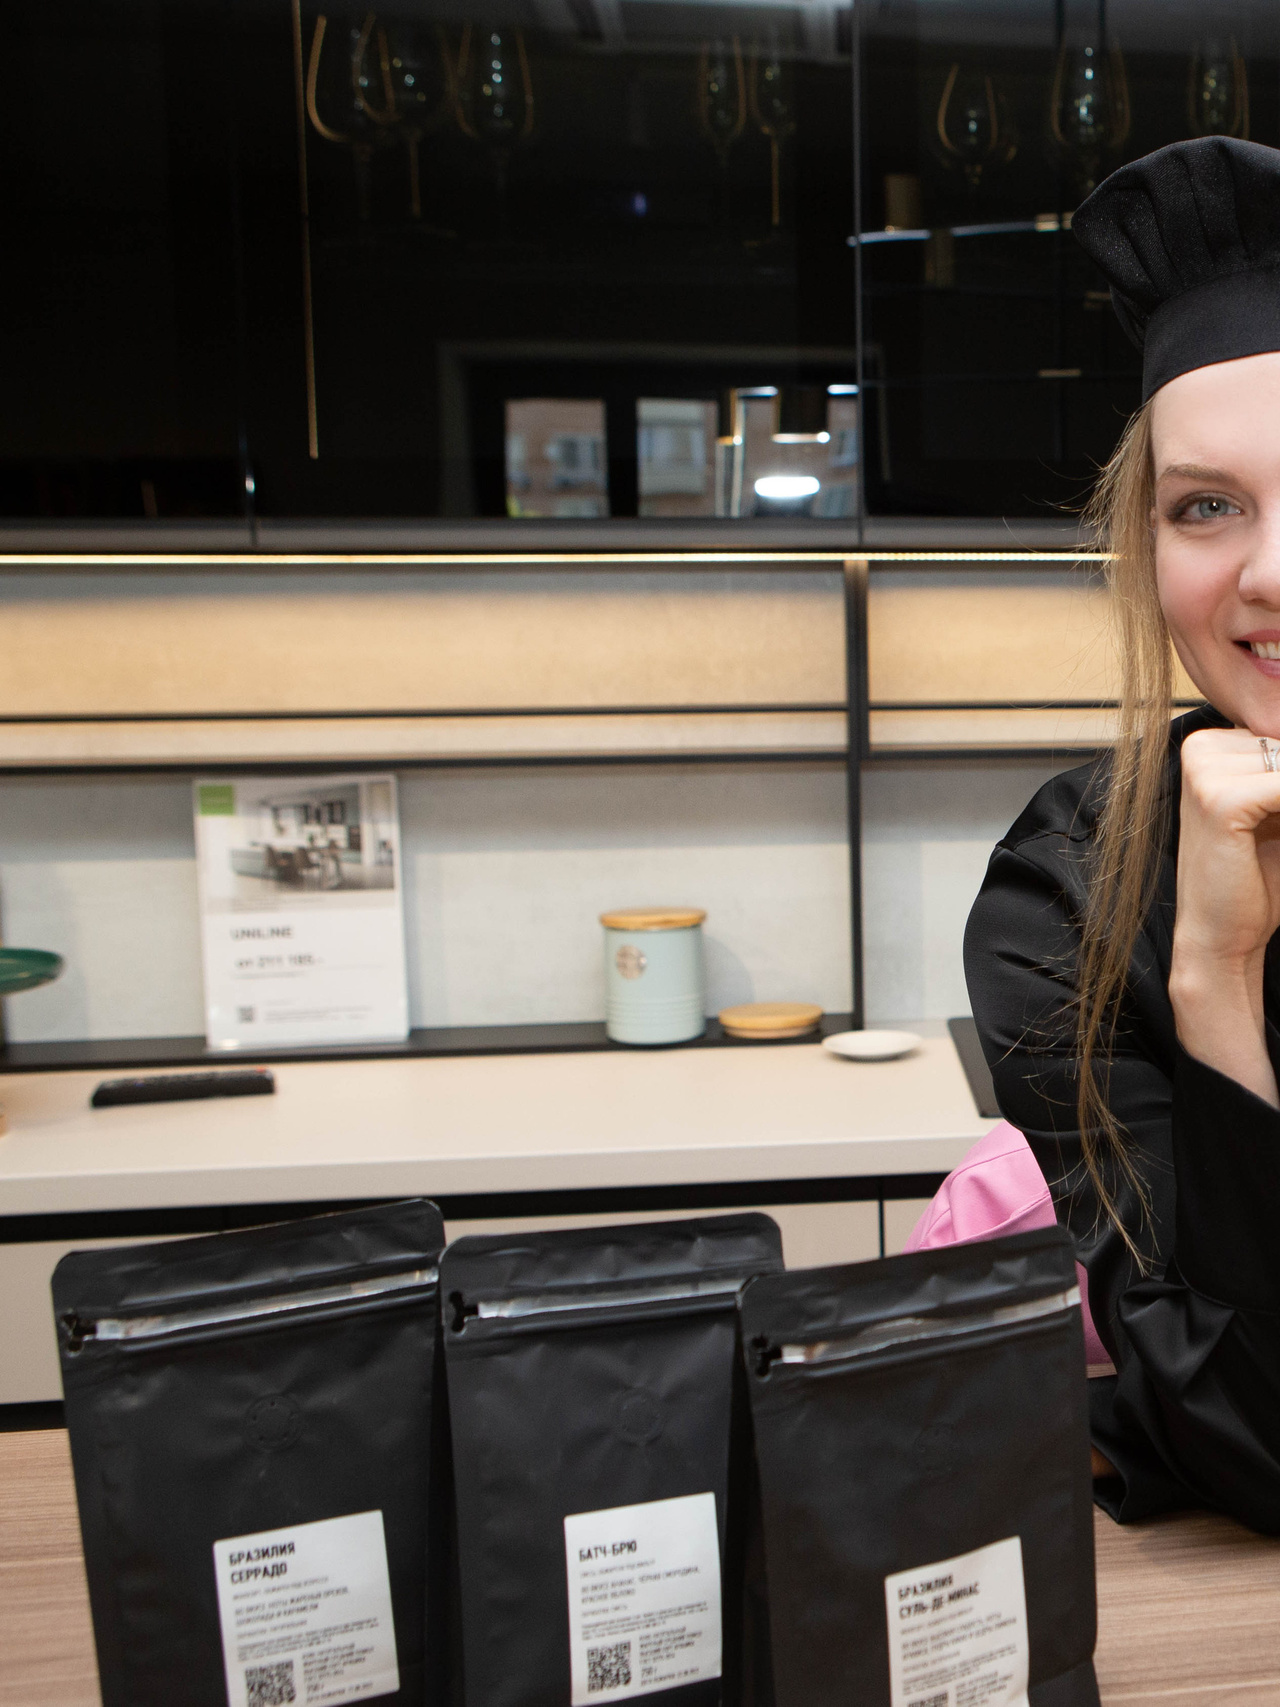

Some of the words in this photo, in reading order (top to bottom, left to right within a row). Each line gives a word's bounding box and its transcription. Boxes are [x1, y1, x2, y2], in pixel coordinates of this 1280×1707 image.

[229, 1542, 295, 1566] БРАЗИЛИЯ
[579, 1540, 637, 1562] БАТЧ-БРЮ
[231, 1563, 288, 1585] СЕРРАДО
[898, 1574, 953, 1598] БРАЗИЛИЯ
